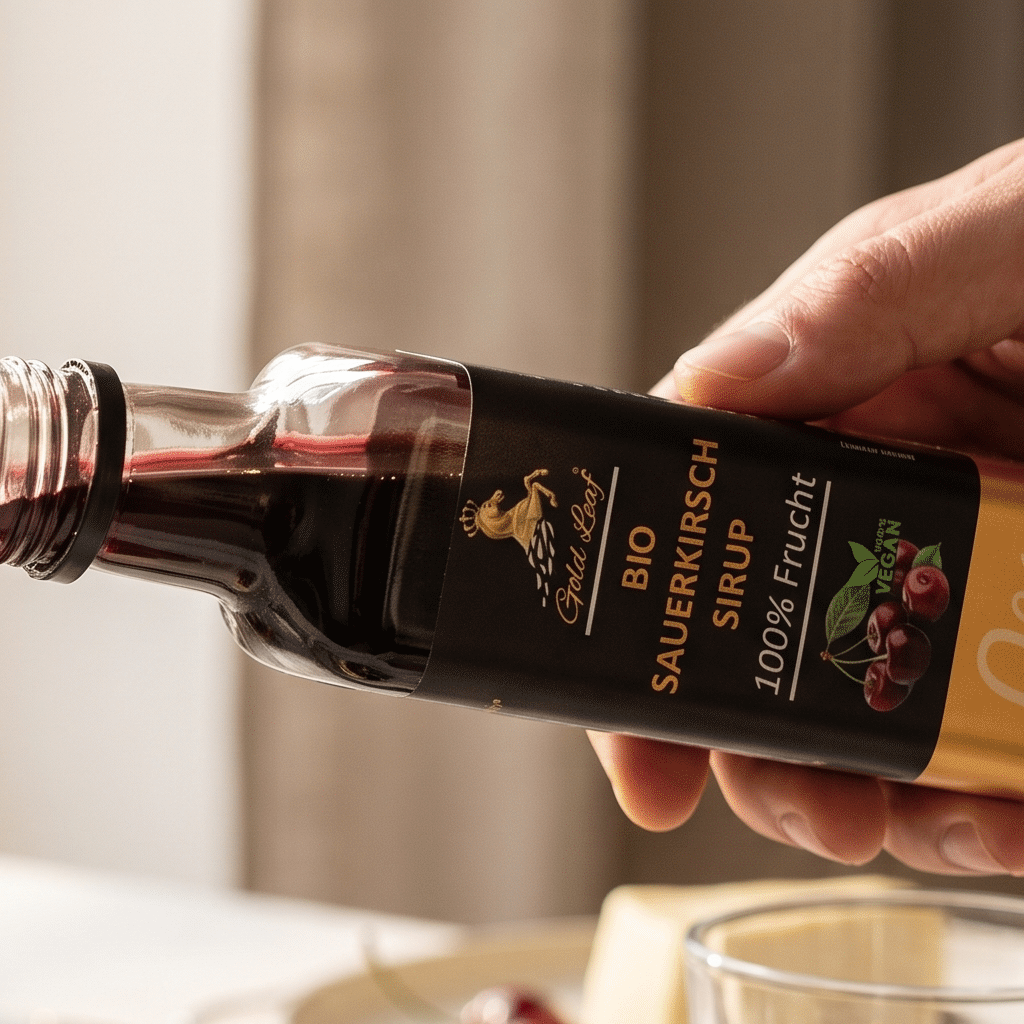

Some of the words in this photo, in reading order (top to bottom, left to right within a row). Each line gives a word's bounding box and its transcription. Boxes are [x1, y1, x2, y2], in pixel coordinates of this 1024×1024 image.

[570, 468, 606, 543] Leaf
[773, 472, 816, 587] Frucht
[555, 545, 587, 625] Gold
[621, 525, 656, 591] BIO
[651, 438, 719, 694] SAUERKIRSCH
[712, 519, 754, 630] SIRUP
[875, 519, 902, 594] VEGAN
[754, 595, 795, 696] 100%
